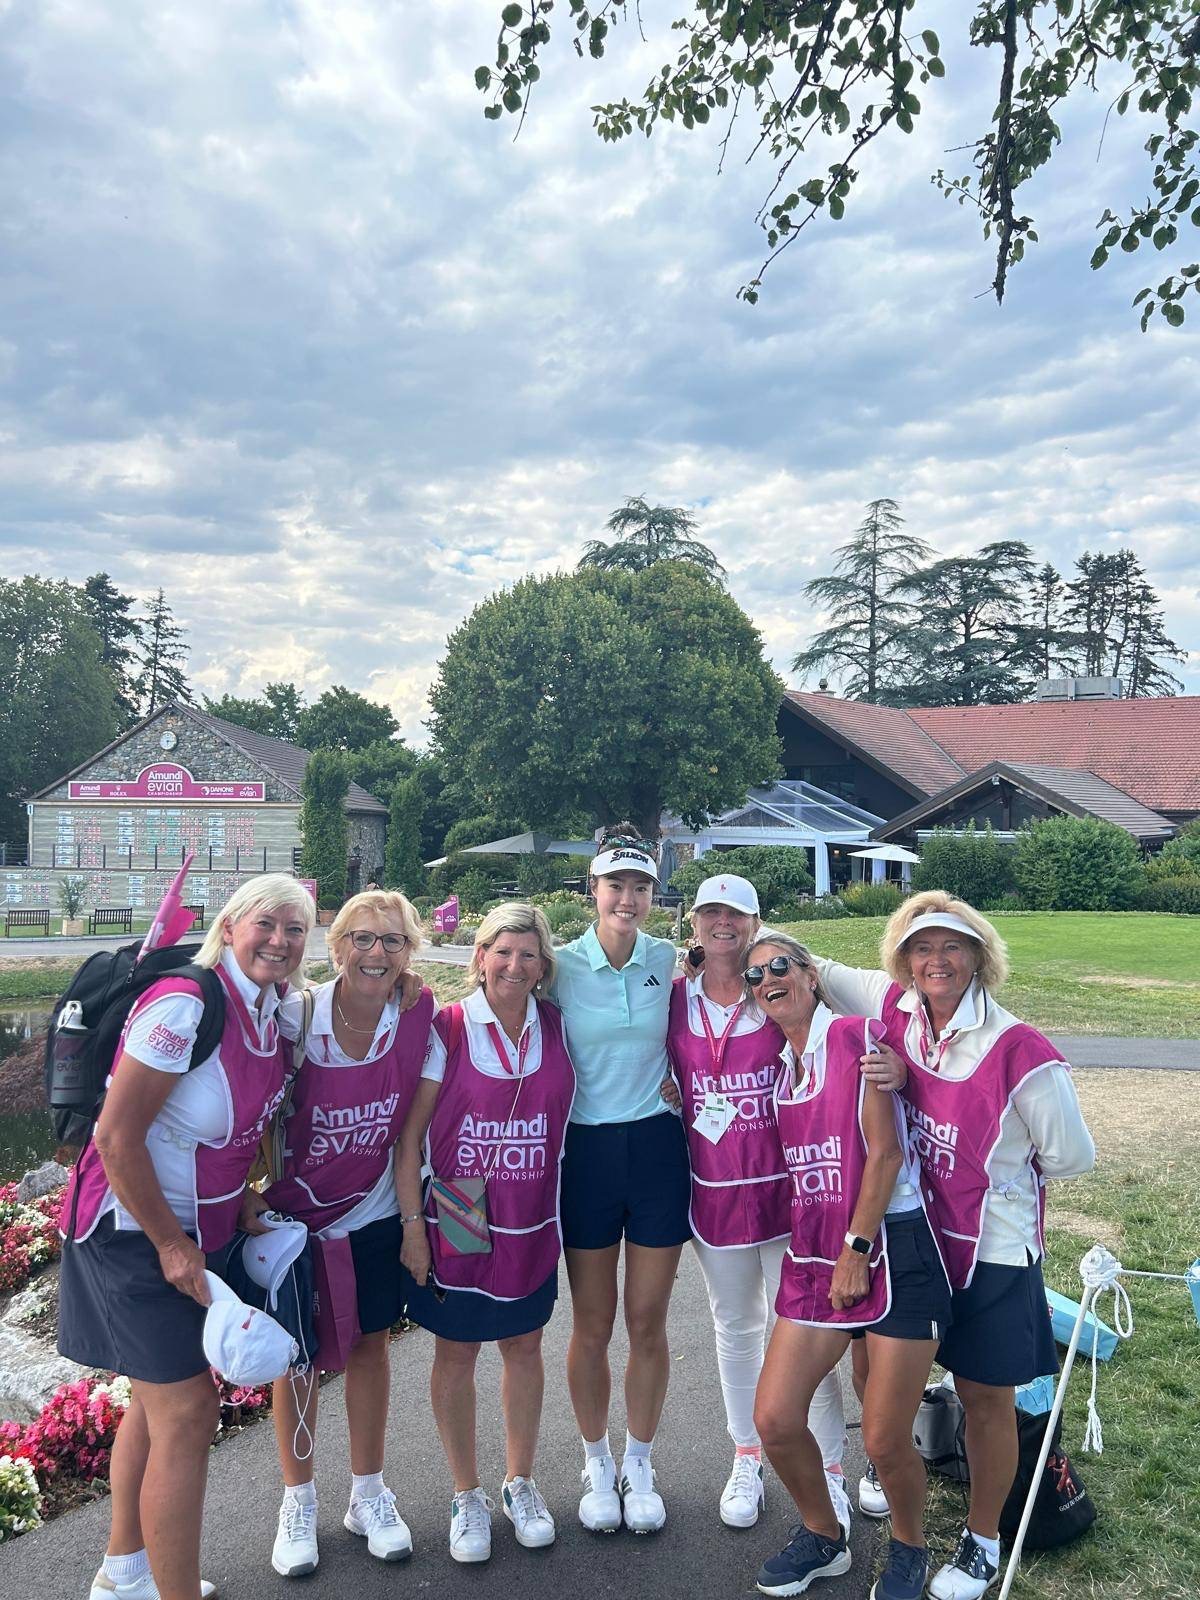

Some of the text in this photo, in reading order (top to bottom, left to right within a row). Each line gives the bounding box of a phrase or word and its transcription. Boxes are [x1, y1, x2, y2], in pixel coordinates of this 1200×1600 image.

[147, 771, 183, 780] Amundi
[147, 781, 183, 792] evian
[239, 789, 257, 797] evian
[148, 1033, 184, 1058] evian
[154, 1023, 190, 1048] Amundi
[311, 1093, 400, 1127] Amundi
[458, 1113, 548, 1139] Amundi
[309, 1126, 389, 1157] evian
[457, 1144, 546, 1170] evian
[792, 1168, 842, 1197] ian
